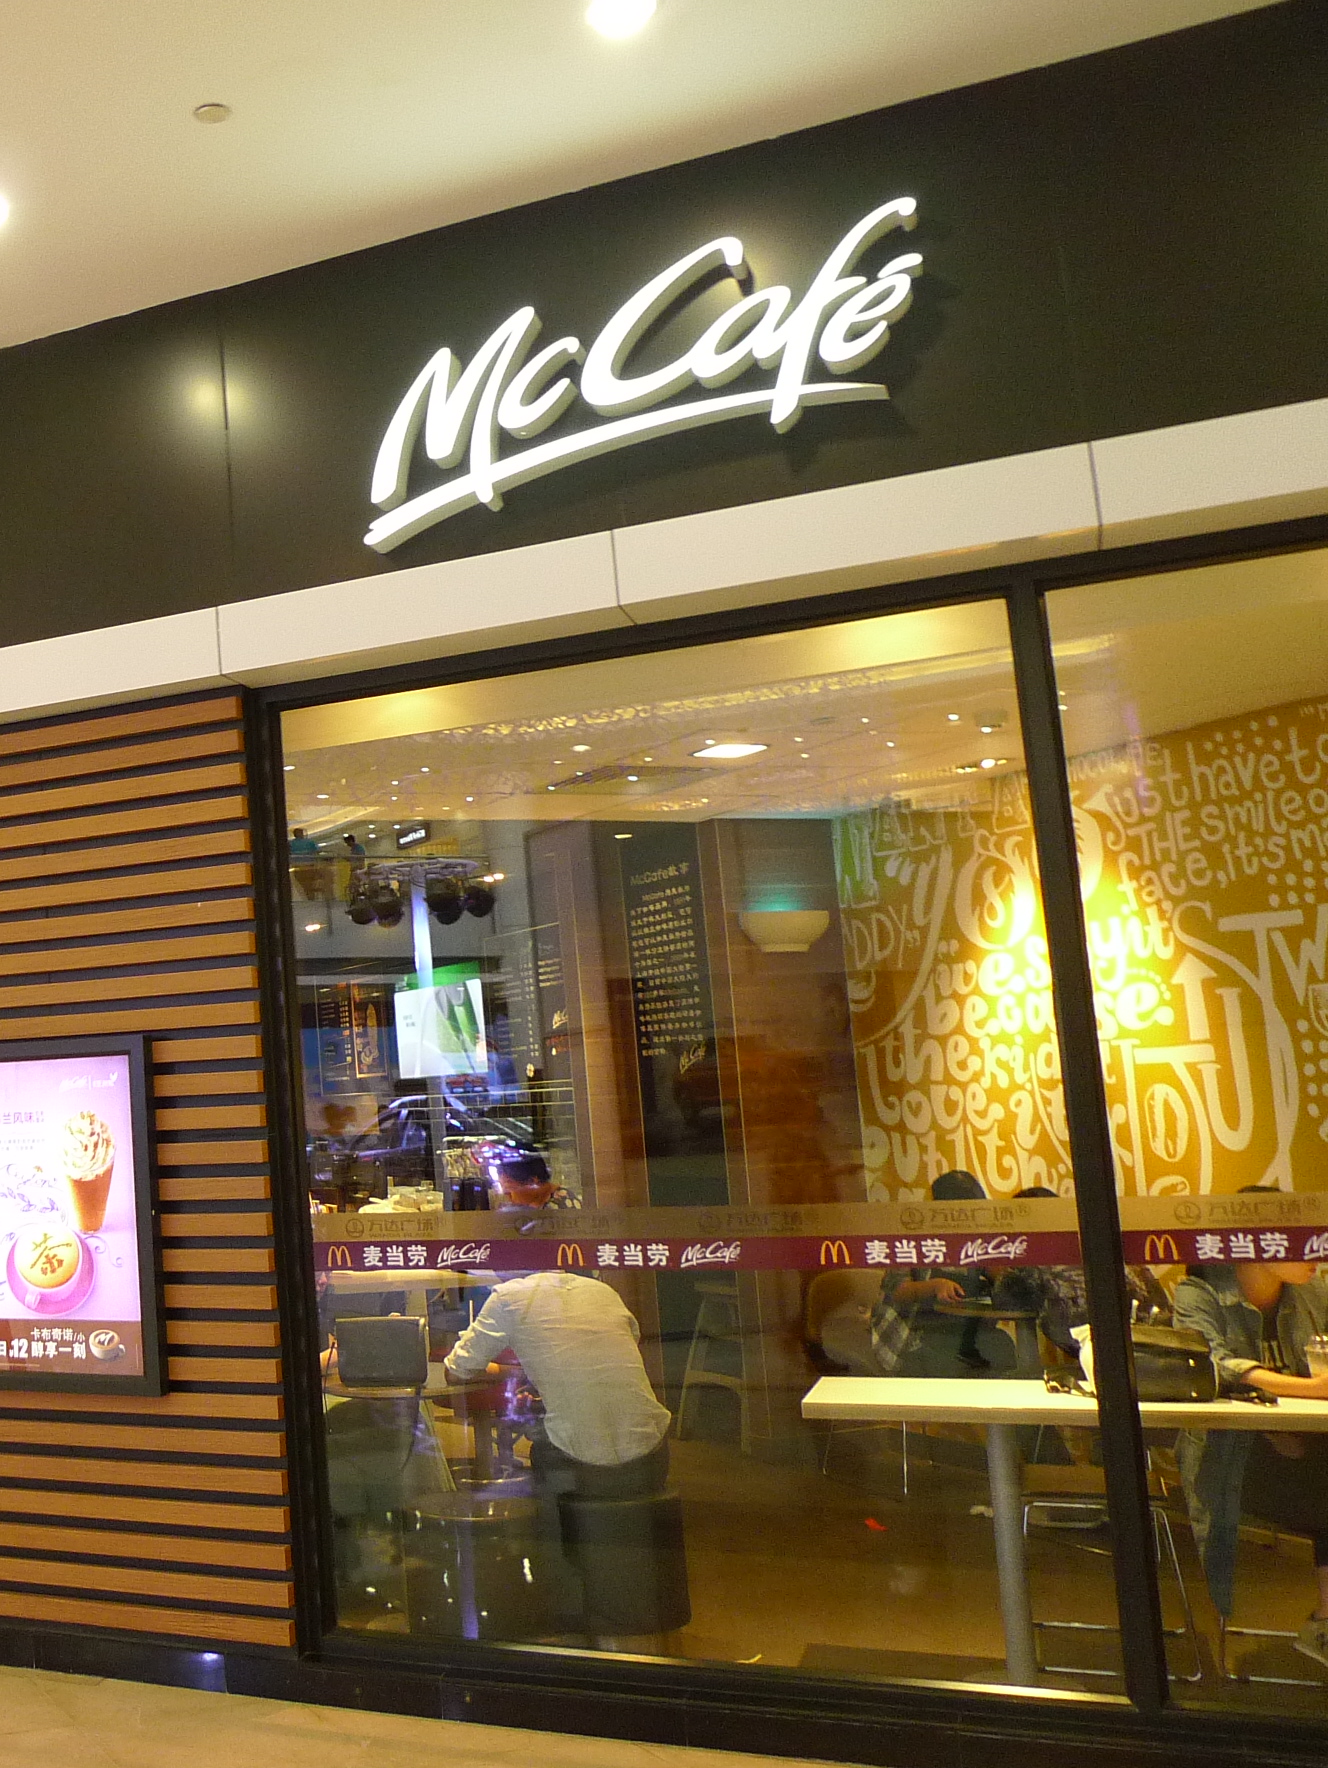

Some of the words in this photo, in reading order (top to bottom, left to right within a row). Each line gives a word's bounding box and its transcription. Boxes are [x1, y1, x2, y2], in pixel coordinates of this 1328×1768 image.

[363, 196, 923, 554] McCafé
[1186, 740, 1287, 802] have
[1126, 808, 1202, 866] THE
[920, 980, 1175, 1040] becase
[363, 1244, 428, 1267] 麦当劳
[596, 1243, 670, 1267] 麦当劳
[864, 1239, 947, 1264] 麦当劳
[1195, 1232, 1289, 1260] 麦当劳
